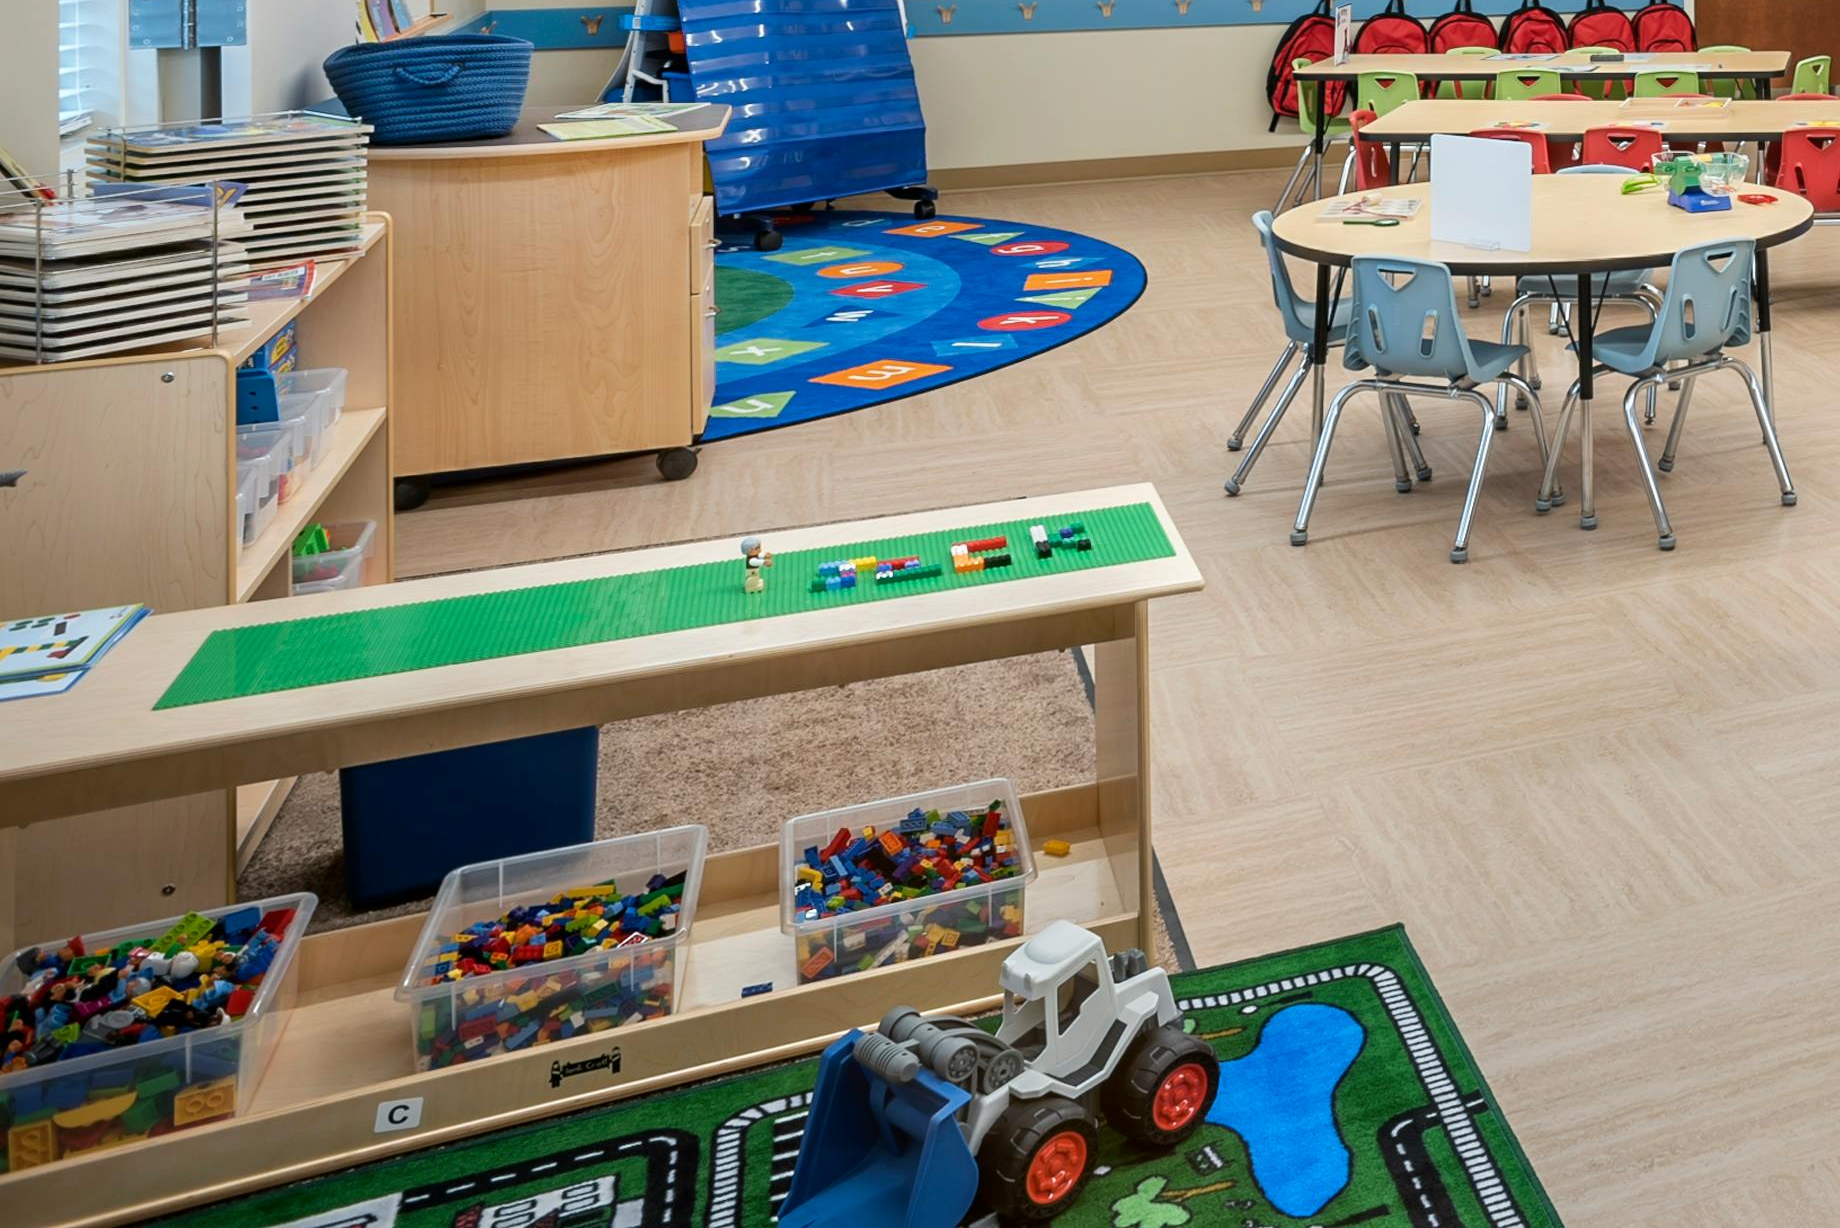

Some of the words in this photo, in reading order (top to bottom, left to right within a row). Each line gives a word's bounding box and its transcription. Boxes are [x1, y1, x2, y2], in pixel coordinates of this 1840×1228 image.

[916, 225, 945, 234] e
[997, 244, 1045, 254] g
[730, 345, 782, 357] x
[388, 1104, 410, 1125] C
